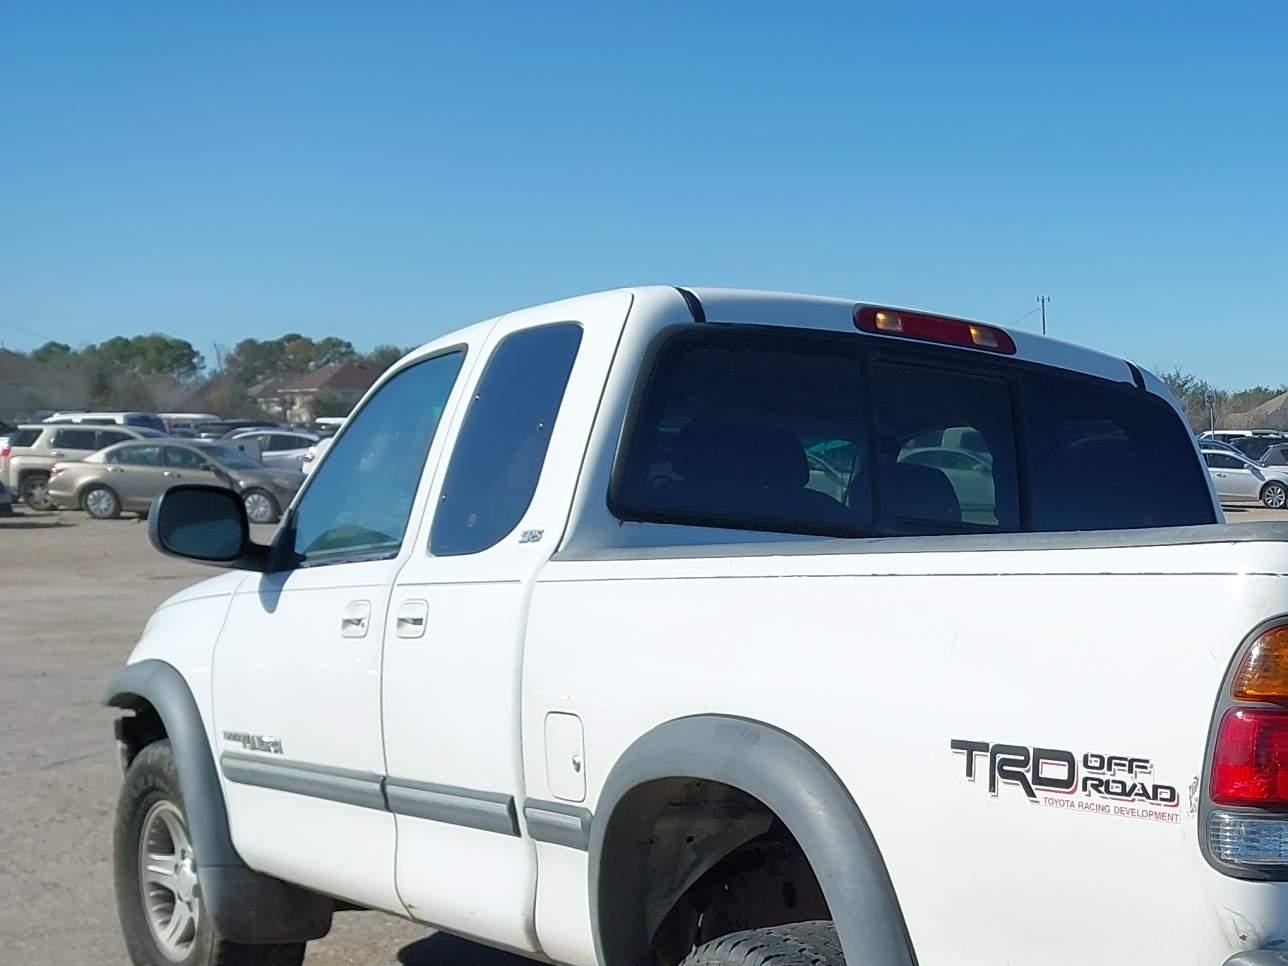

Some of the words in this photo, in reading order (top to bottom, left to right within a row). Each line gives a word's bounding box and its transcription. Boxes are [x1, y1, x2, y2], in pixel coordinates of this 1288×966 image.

[951, 739, 1079, 803] TRD
[1082, 753, 1152, 777] OFF
[1081, 776, 1178, 808] ROAD
[1043, 796, 1076, 810] TOYOTA
[1077, 801, 1111, 815] RACING
[1113, 805, 1181, 823] DEVELOPMENT
